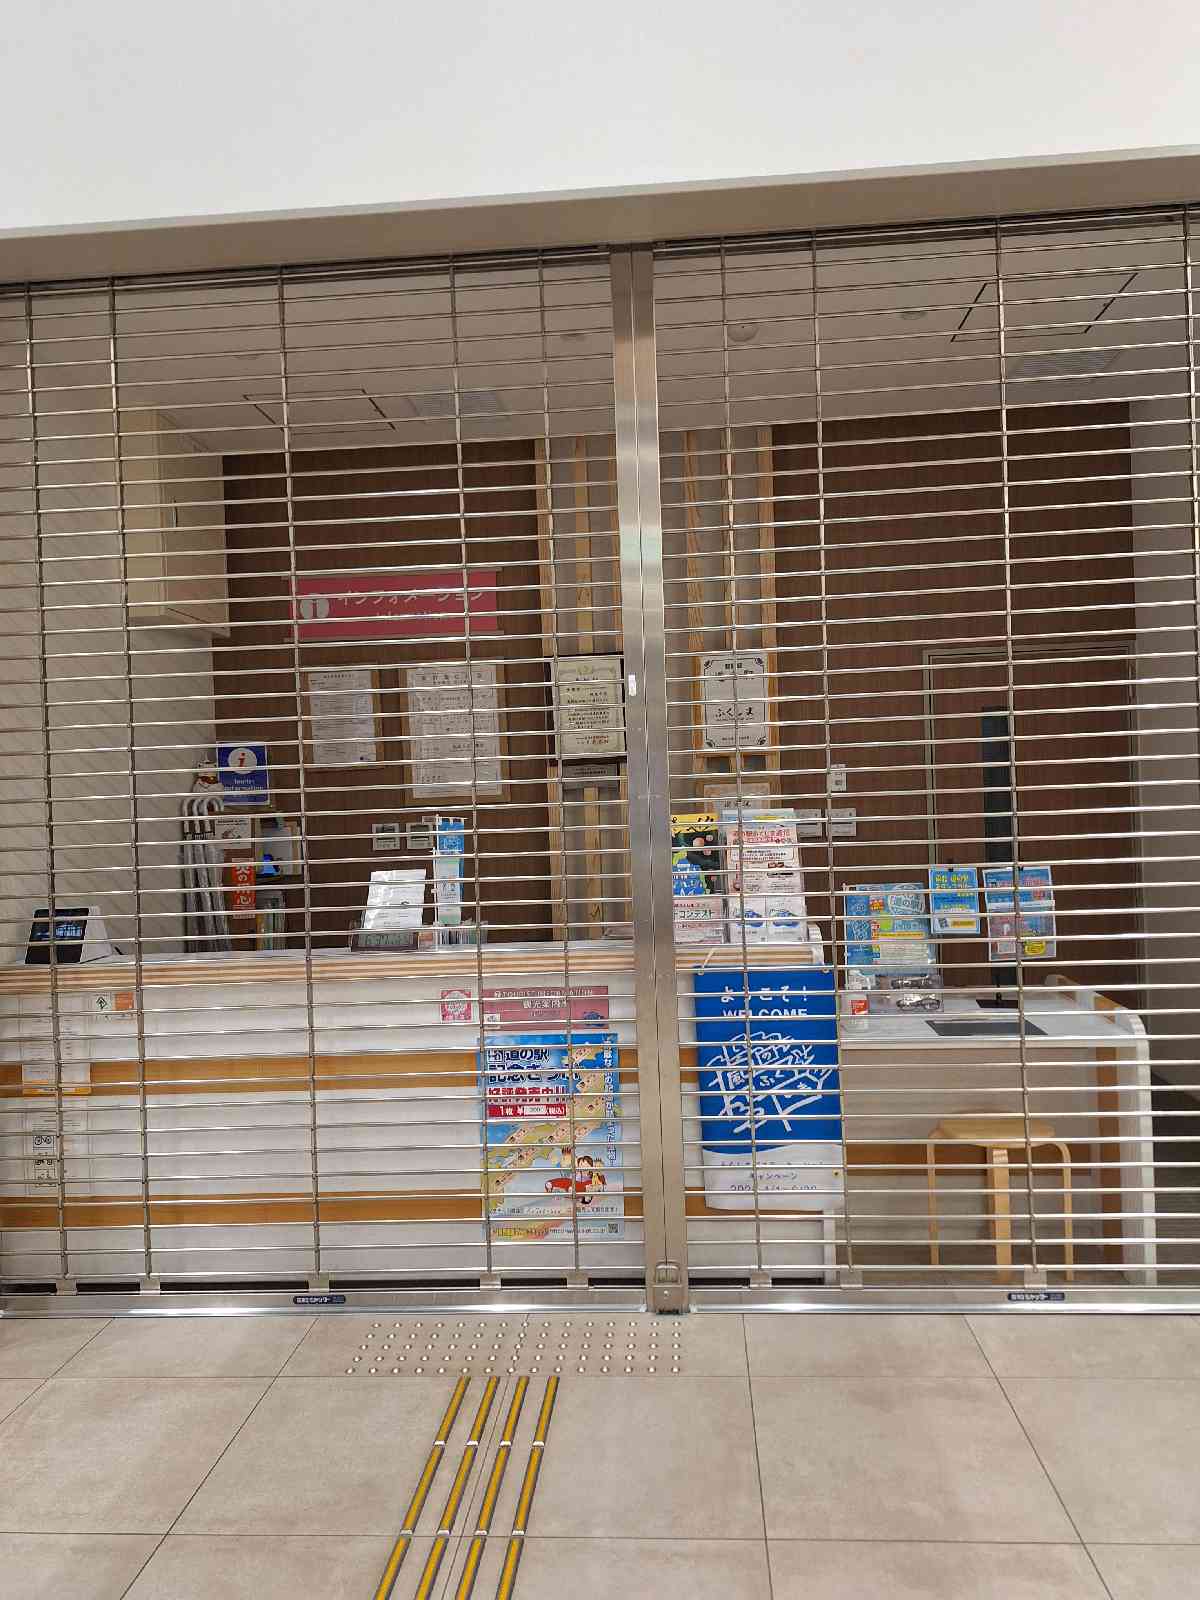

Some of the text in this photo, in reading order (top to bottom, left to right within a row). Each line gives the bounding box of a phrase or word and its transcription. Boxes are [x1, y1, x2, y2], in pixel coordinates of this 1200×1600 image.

[337, 586, 485, 607] インフォメション
